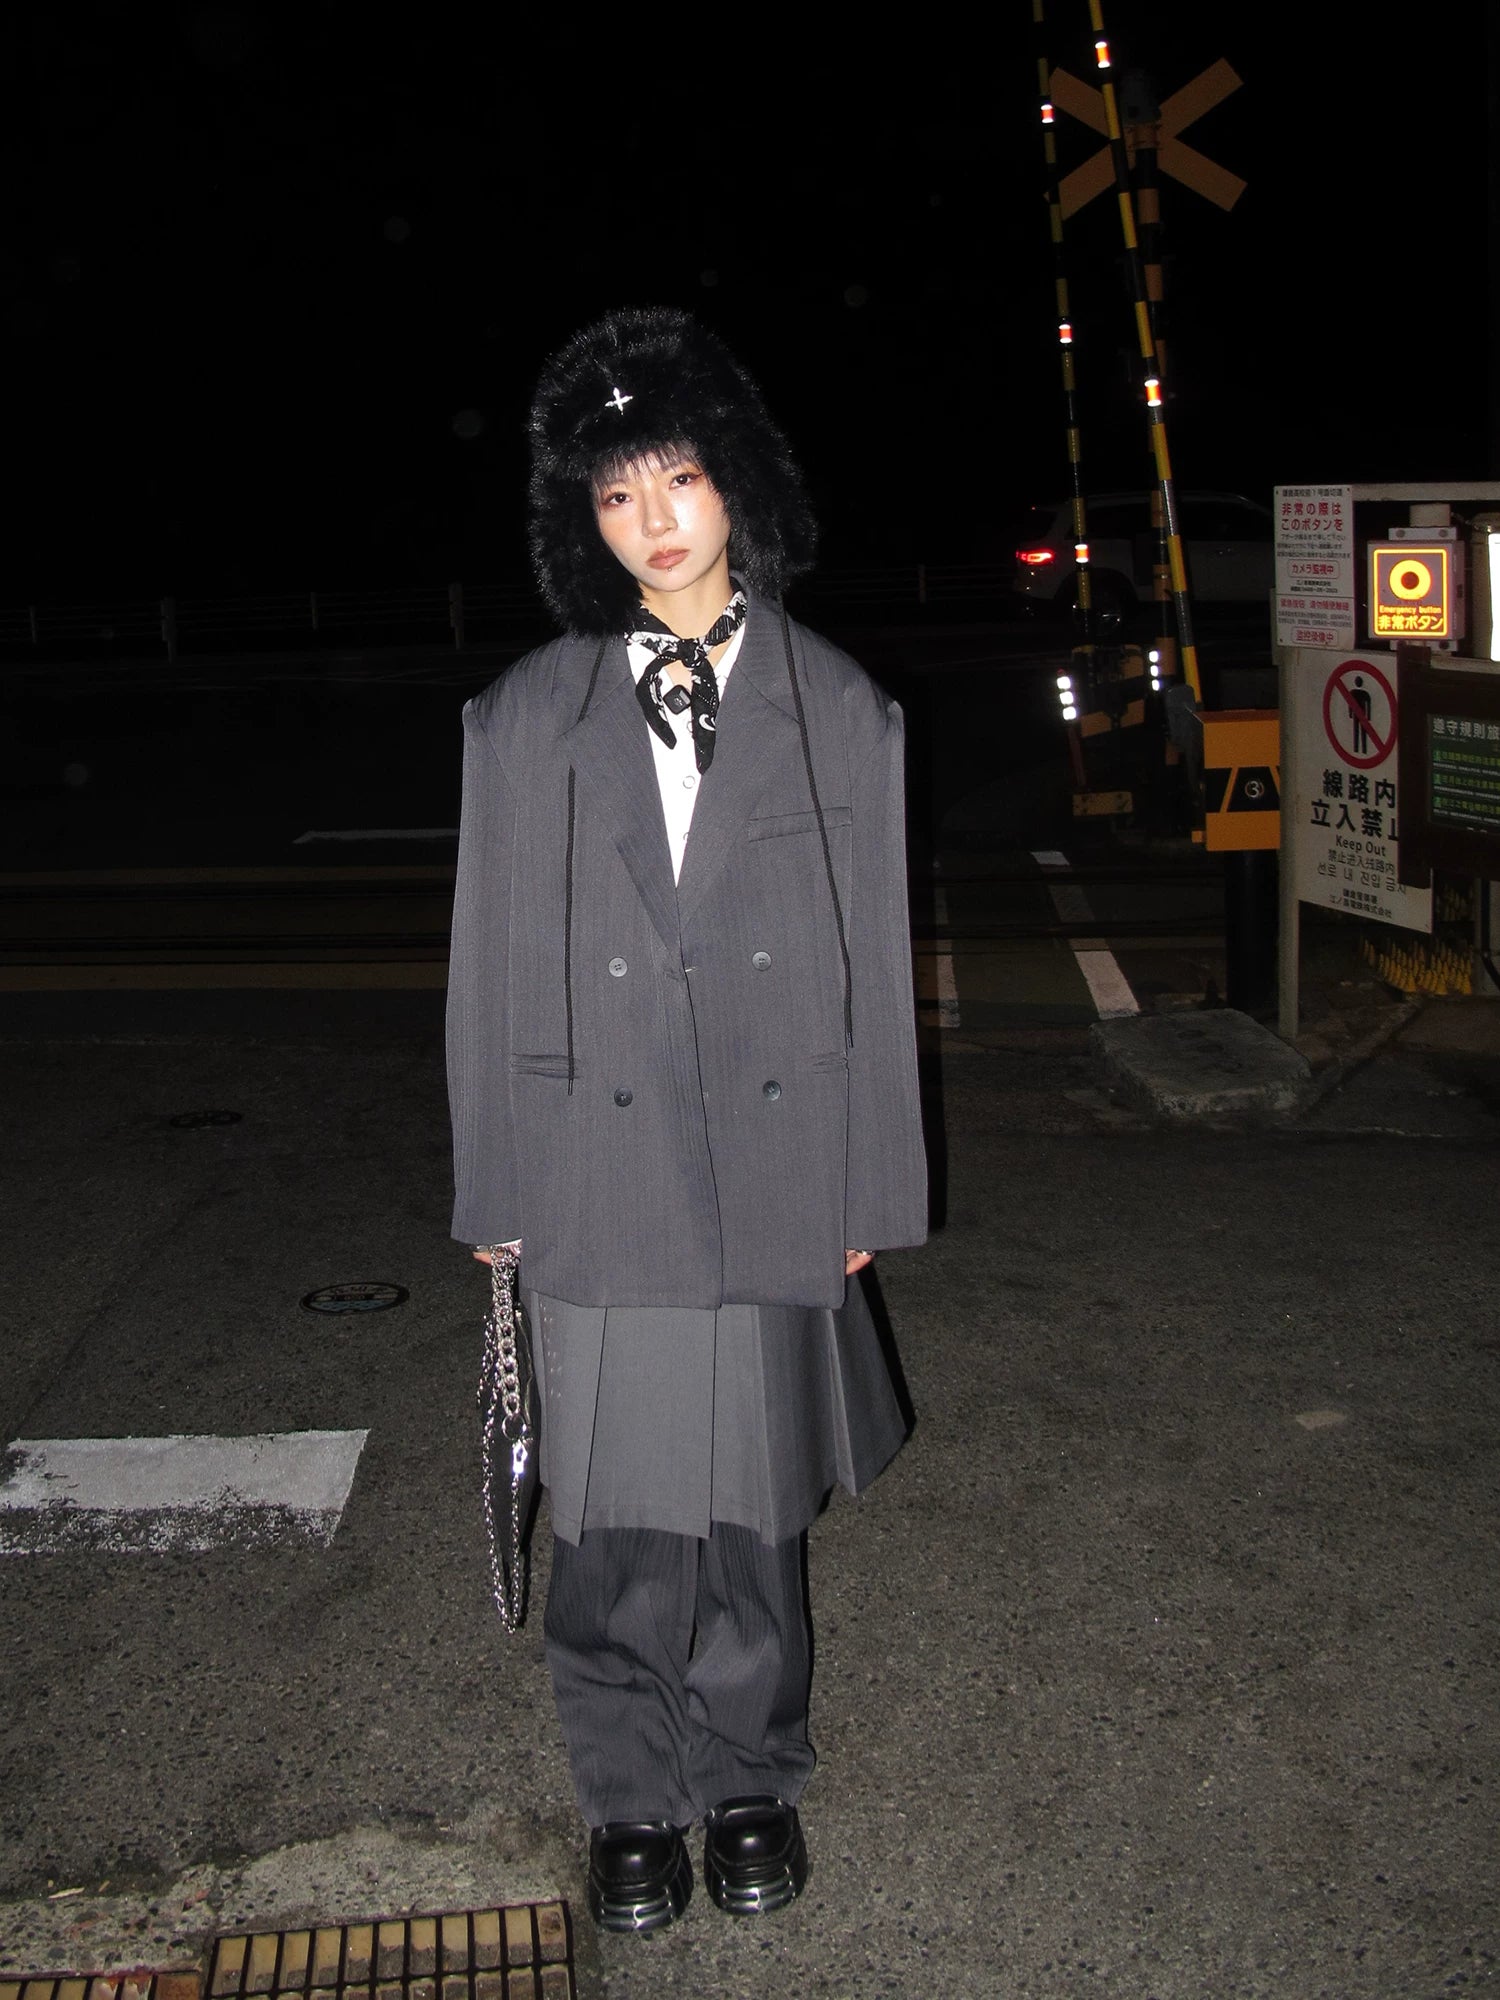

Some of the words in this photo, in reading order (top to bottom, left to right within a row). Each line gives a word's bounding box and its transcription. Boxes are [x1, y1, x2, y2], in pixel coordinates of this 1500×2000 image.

[1281, 502, 1342, 516] 非常の際は
[1281, 518, 1343, 532] このボタンを
[1292, 564, 1334, 575] カメラ監視中
[1379, 605, 1417, 615] Emergency
[1418, 606, 1442, 614] button
[1378, 614, 1444, 631] 非常ボタン
[1322, 768, 1396, 809] 線路内
[1336, 834, 1362, 853] Keep
[1366, 841, 1386, 857] Out
[1318, 861, 1337, 878] 선로
[1343, 866, 1353, 882] 내
[1360, 870, 1380, 889] 진입
